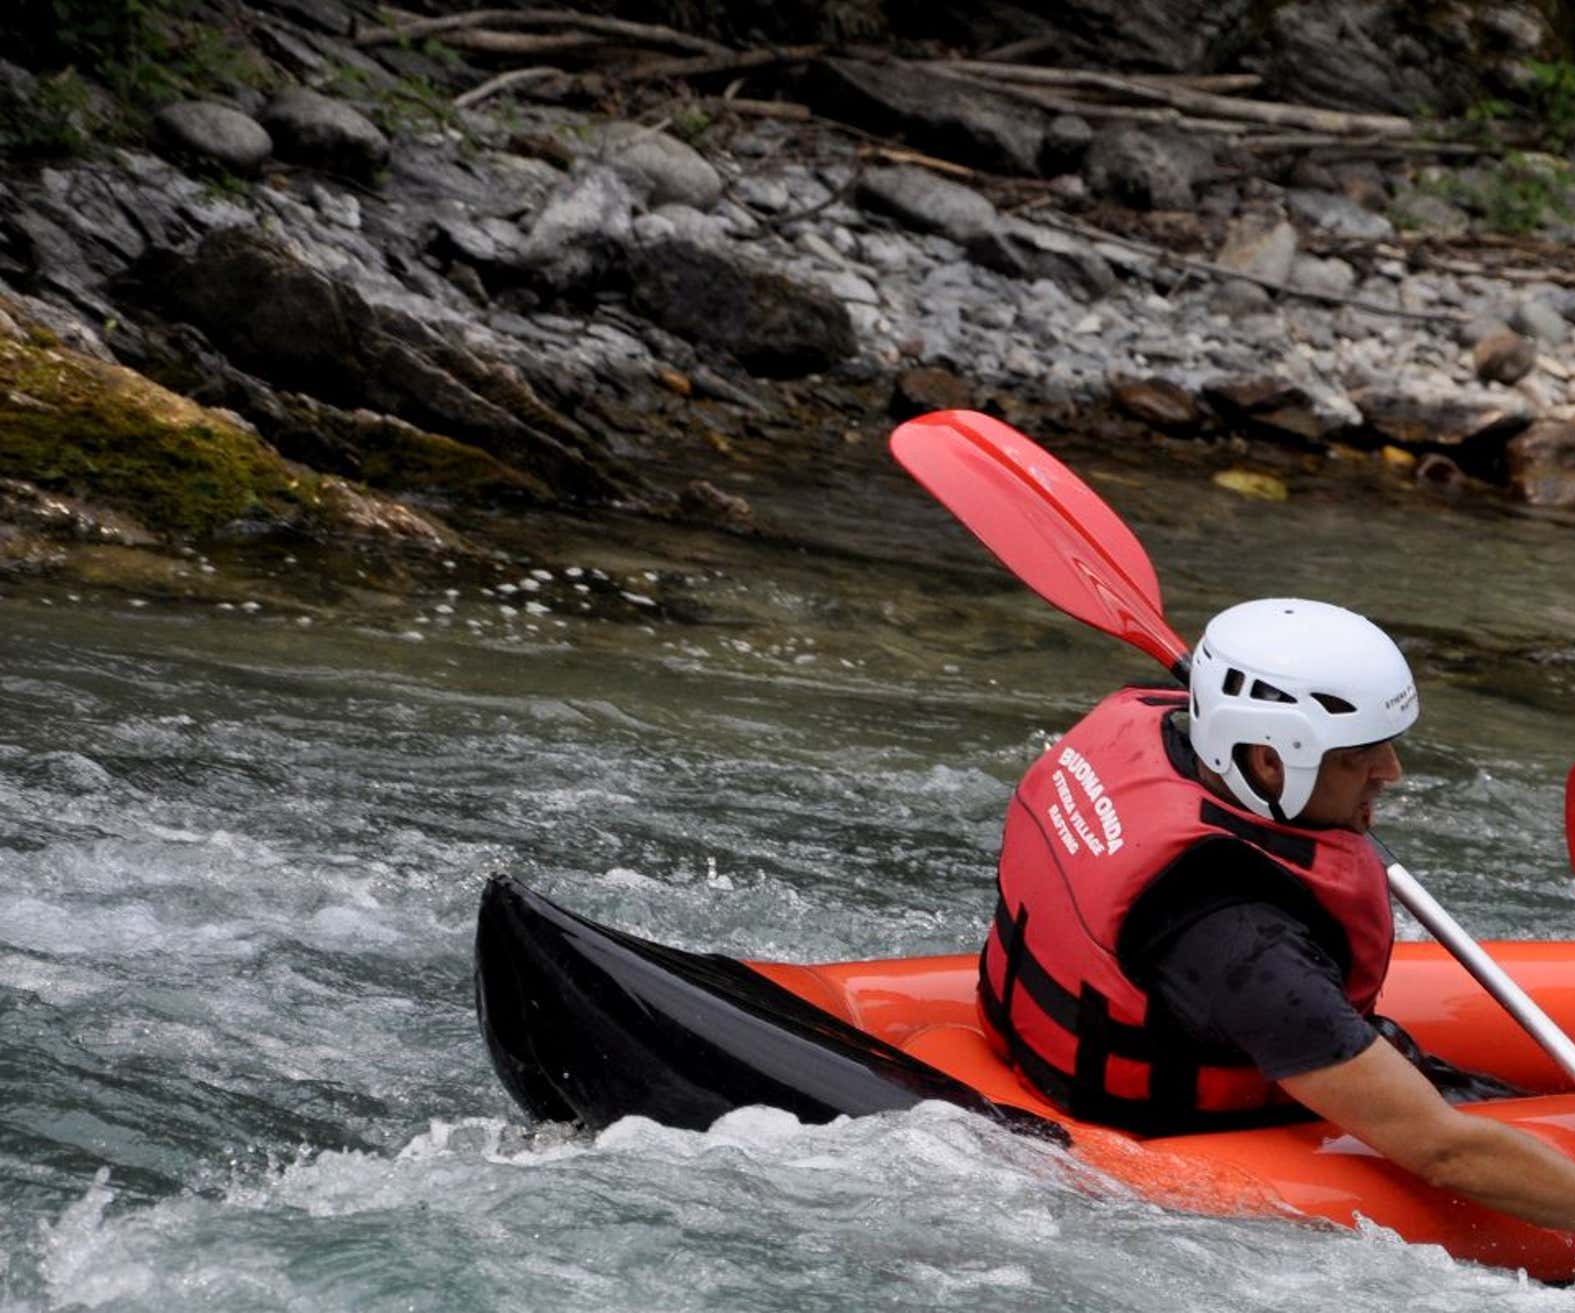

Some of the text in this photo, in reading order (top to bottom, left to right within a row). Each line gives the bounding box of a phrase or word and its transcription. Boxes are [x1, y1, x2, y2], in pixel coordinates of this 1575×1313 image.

[1058, 747, 1124, 855] BUONA ONDA
[1048, 804, 1079, 855] RAFTING
[1069, 810, 1105, 856] VILLAGE
